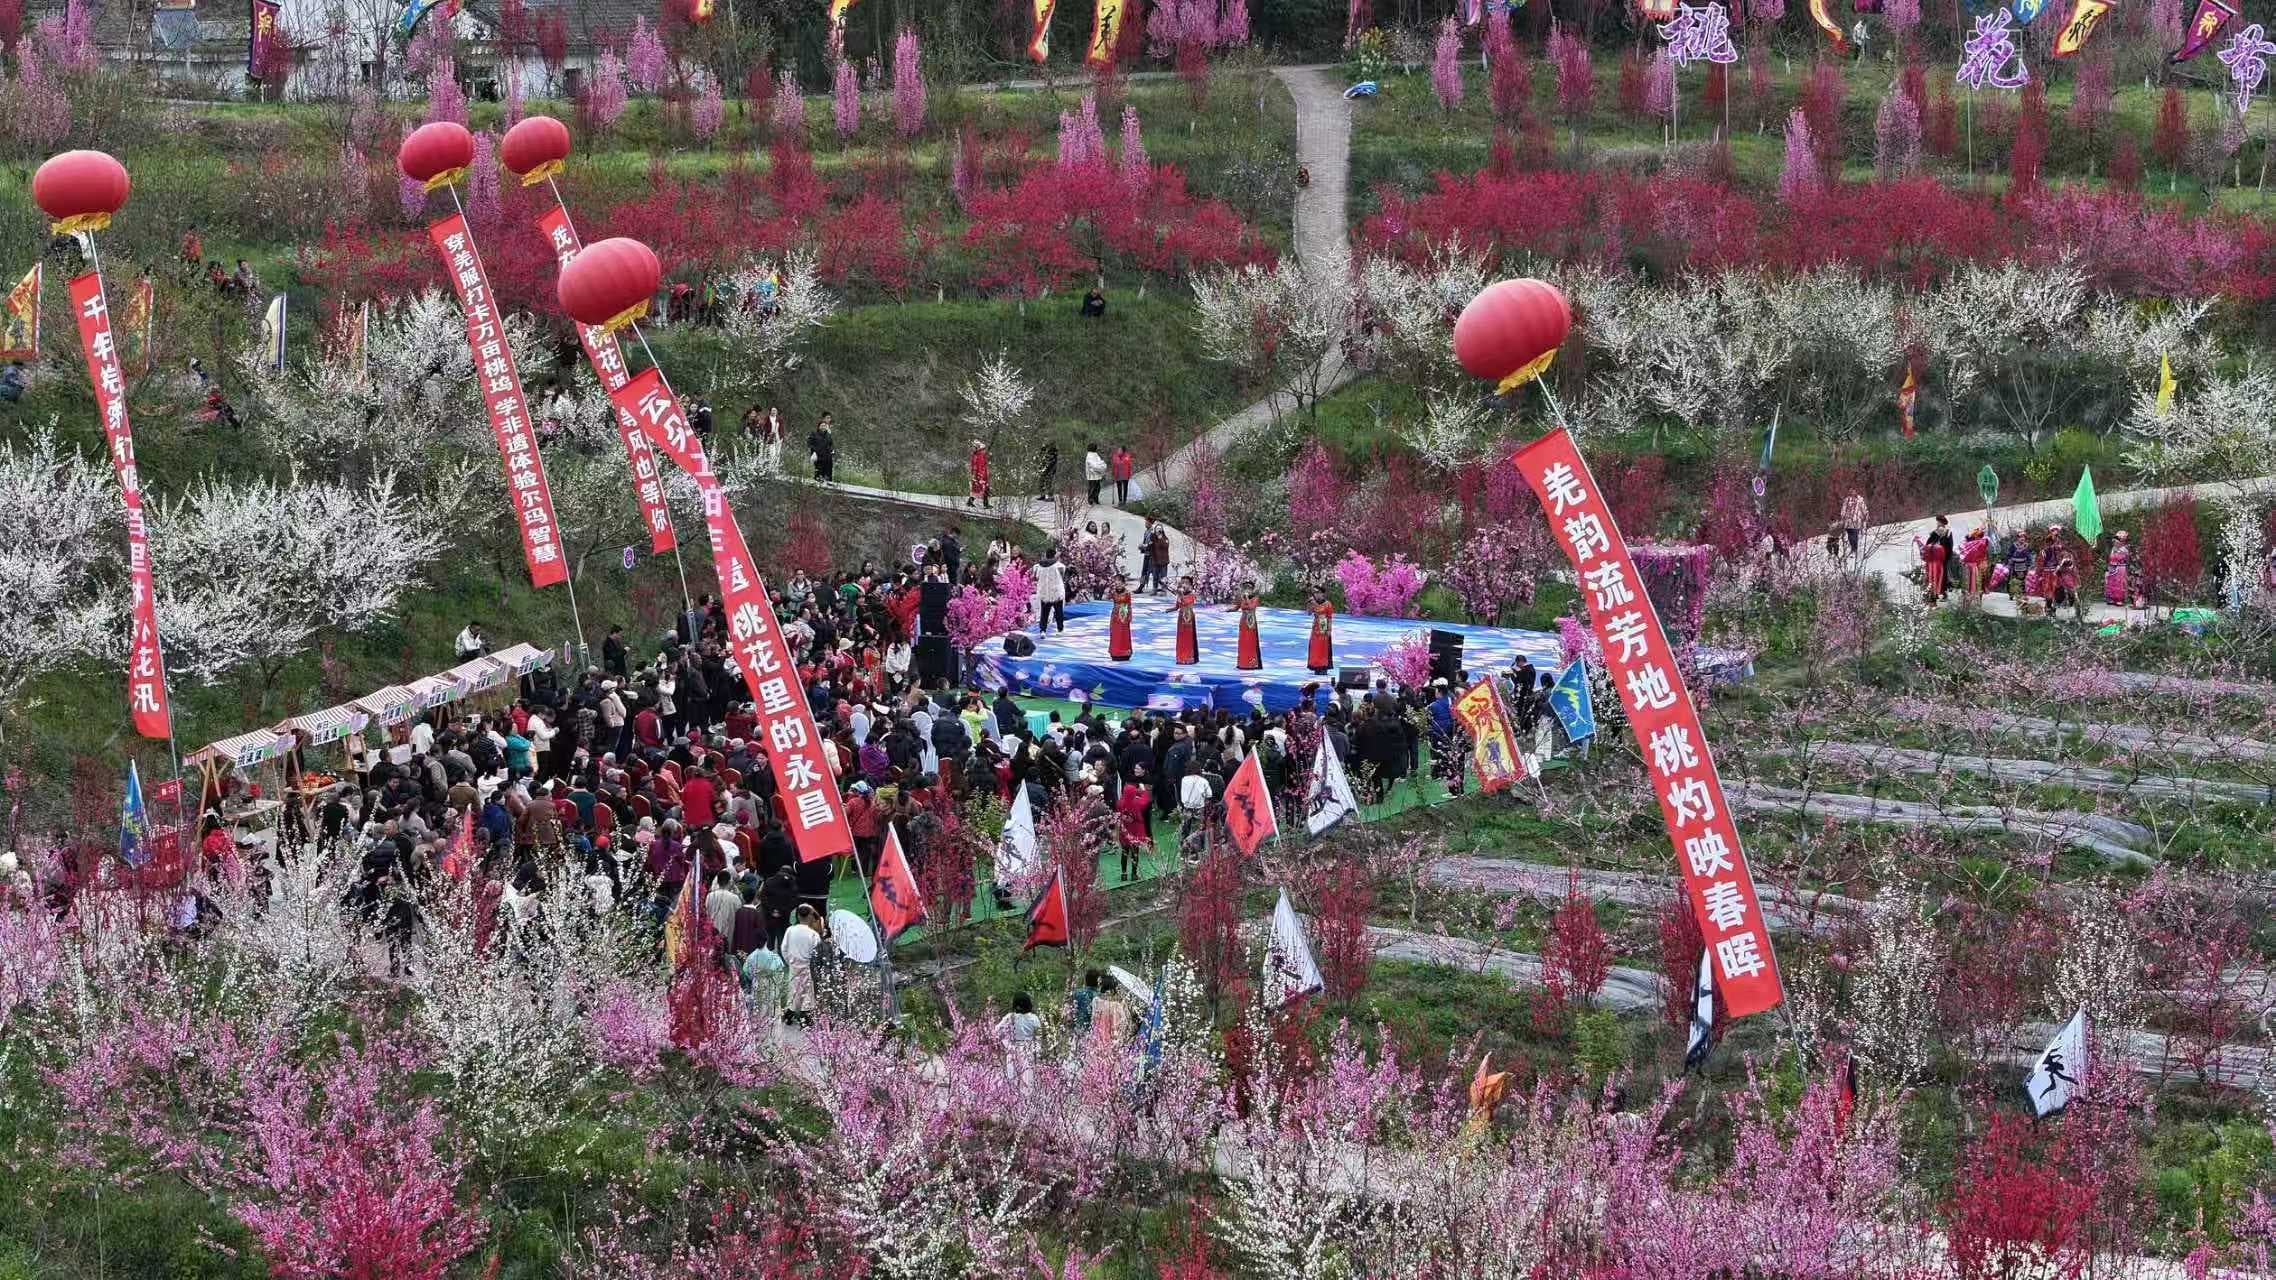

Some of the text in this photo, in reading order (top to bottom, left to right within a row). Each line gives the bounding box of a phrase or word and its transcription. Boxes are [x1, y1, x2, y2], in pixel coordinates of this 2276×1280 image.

[731, 601, 835, 830] 桃花里的永昌
[1542, 461, 1765, 979] 羌韵流芳地 桃灼映春晖
